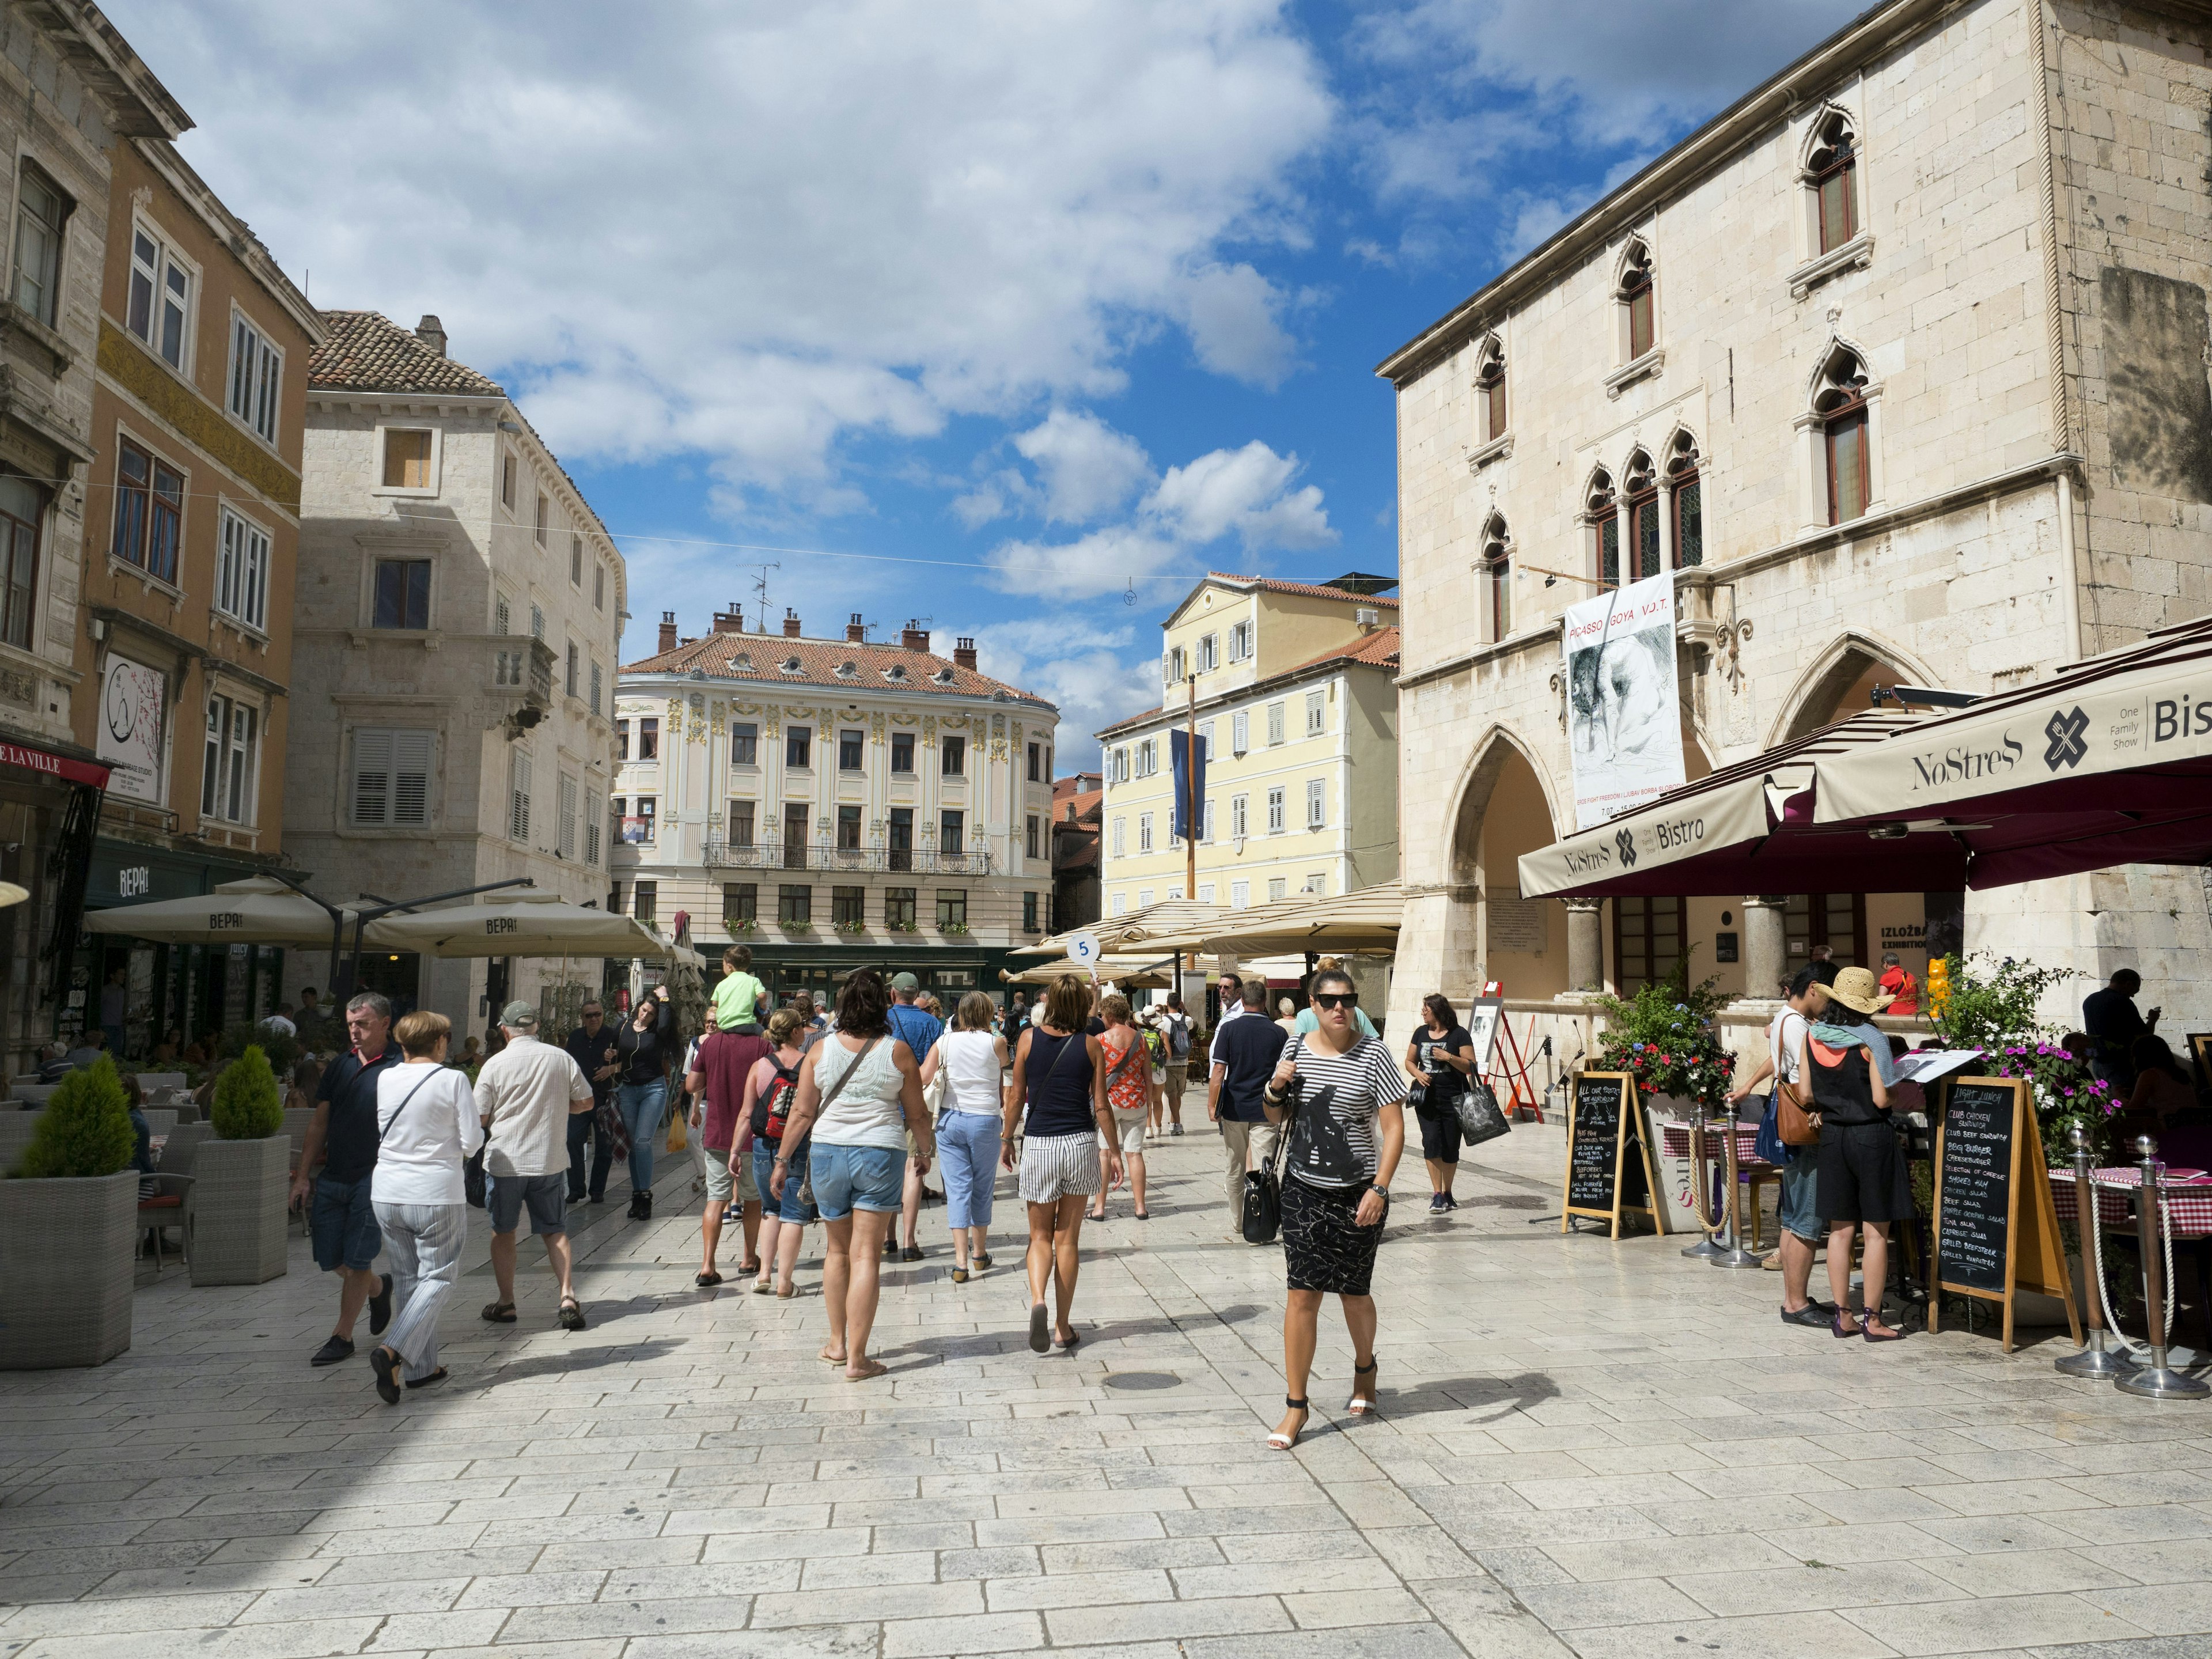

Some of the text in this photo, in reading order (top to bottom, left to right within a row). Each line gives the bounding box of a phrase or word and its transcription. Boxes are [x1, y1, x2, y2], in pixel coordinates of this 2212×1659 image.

[1570, 620, 1603, 639] PICASSO
[1610, 610, 1634, 626] GOYA
[2120, 708, 2138, 719] One
[2111, 722, 2139, 736] Family
[2113, 738, 2138, 750] Show
[9, 747, 26, 766] LA
[26, 751, 60, 774] VILLE
[138, 767, 152, 776] STUDIO
[1587, 796, 1599, 804] FIGHT
[1599, 793, 1620, 801] FREEDOM
[1623, 789, 1641, 798] LJUBAV
[1641, 787, 1658, 795] BORBA
[1656, 819, 1703, 850] Bistro
[1642, 838, 1654, 846] Family
[1079, 941, 1089, 956] 5
[1578, 1084, 1589, 1097] ALL
[1592, 1086, 1602, 1095] OUR
[1954, 1088, 2002, 1104] LIGHT LUNCH
[1948, 1110, 1991, 1123] CLUB CHICKEN
[1958, 1120, 1986, 1132] SANDWICH
[1946, 1129, 1961, 1137] CLUB
[1979, 1132, 2008, 1142] SANDWICH
[1947, 1142, 1993, 1156] BBQ BURGER
[1946, 1154, 1991, 1166] CHEESEBURGER
[1945, 1164, 1971, 1174] SELECTION
[1982, 1171, 2006, 1181] CHEESE
[1948, 1175, 1989, 1190] SMOKED HAM
[1943, 1187, 1966, 1195] CHICKEN
[1944, 1196, 1981, 1208] BEEF SALAD
[1943, 1206, 2006, 1224] PURPLE OCTOPUS SALAD
[1943, 1217, 1976, 1229] TUNA SALAD
[1942, 1228, 1987, 1240] CAPRESE SALAD
[1941, 1238, 1997, 1257] GRILLED BEEFSTEAK
[1941, 1250, 1995, 1268] GRILLED RUMPSTEAK
